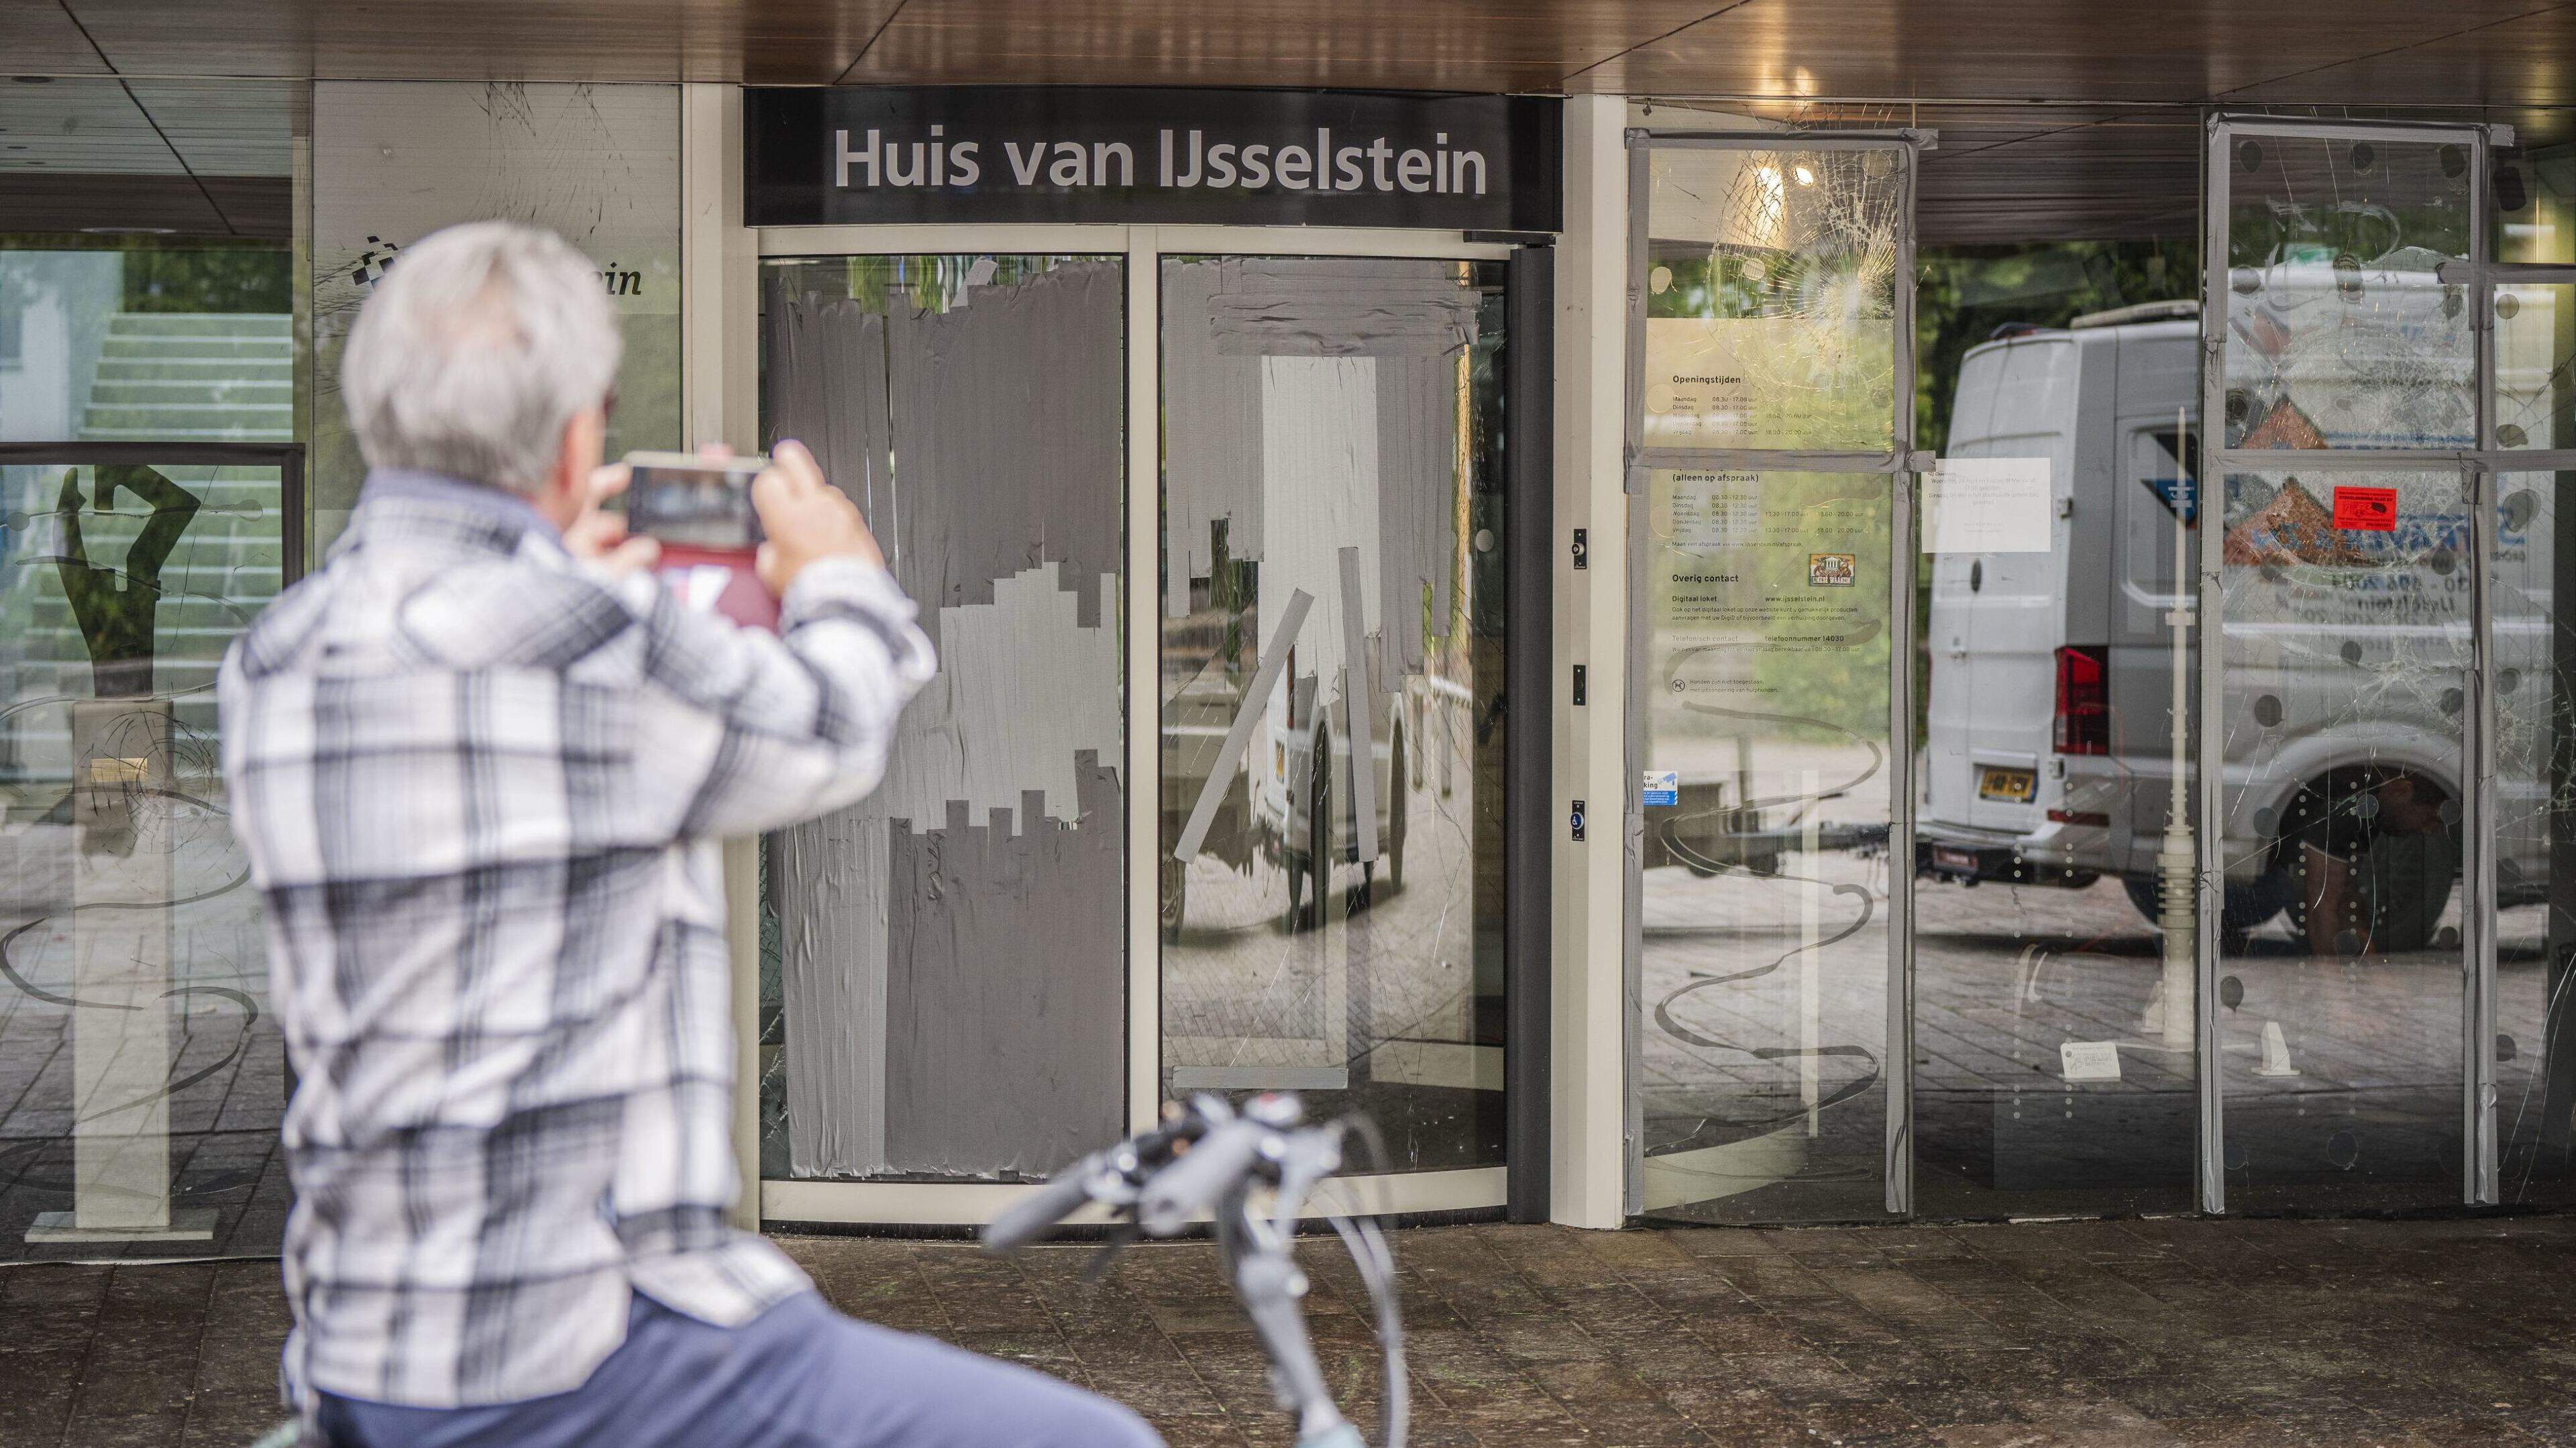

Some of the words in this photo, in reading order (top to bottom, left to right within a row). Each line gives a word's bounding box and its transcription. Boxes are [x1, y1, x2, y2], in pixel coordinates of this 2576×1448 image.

[835, 125, 980, 188] Huis
[1004, 142, 1133, 187] van
[1161, 127, 1487, 195] IJsselstein
[1672, 375, 1741, 385] Openingstijden
[1672, 474, 1703, 482] (alleen
[1717, 474, 1759, 483] afspraak)
[1672, 574, 1702, 583] Overig
[1705, 574, 1739, 582] contact
[1672, 595, 1699, 603] Digitaal
[1765, 595, 1825, 603] www.ijsselstein.nl
[1644, 781, 1658, 789] king
